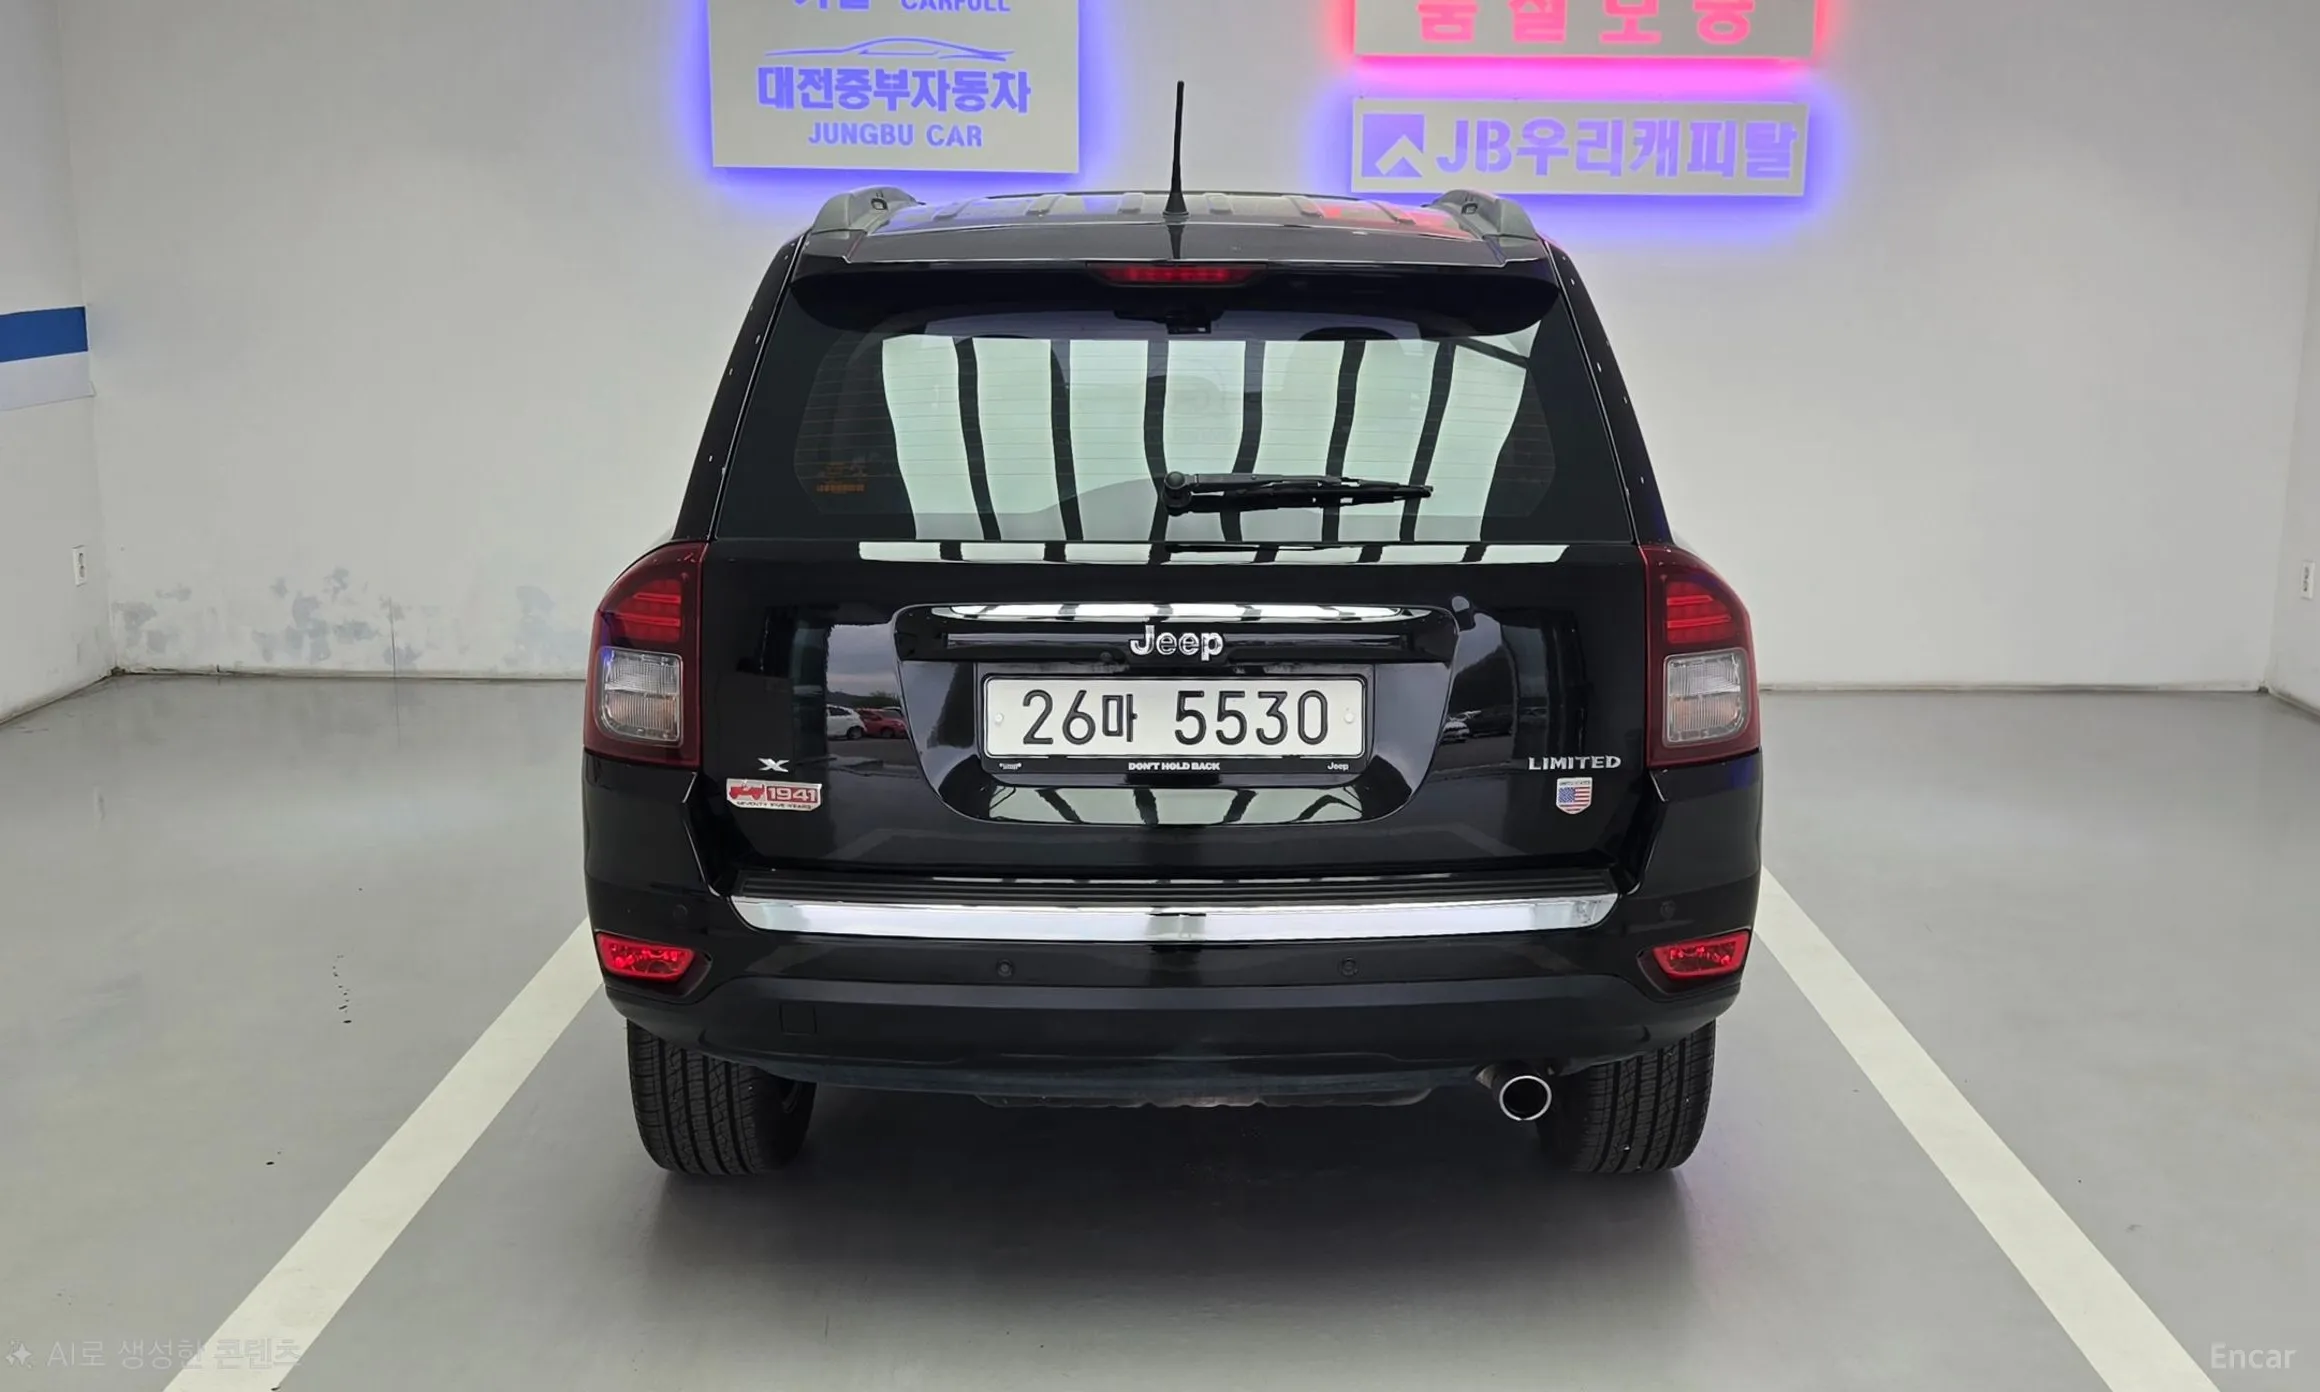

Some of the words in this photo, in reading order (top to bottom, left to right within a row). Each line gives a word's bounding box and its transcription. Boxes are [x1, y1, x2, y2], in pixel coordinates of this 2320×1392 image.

[757, 66, 1031, 114] 대전중부자동차
[808, 122, 914, 146] JUNGBU
[926, 124, 983, 147] CAR
[1435, 117, 1798, 178] JB우리캐피탈
[1130, 624, 1224, 661] Jeep
[1022, 689, 1138, 745] 26마
[1174, 690, 1329, 745] 5530
[1128, 762, 1160, 771] DON'T
[1161, 762, 1191, 771] HOLD
[1191, 762, 1221, 771] BACK
[1327, 761, 1349, 771] Jeep
[1528, 755, 1622, 771] LIMITED
[768, 786, 817, 802] 1941
